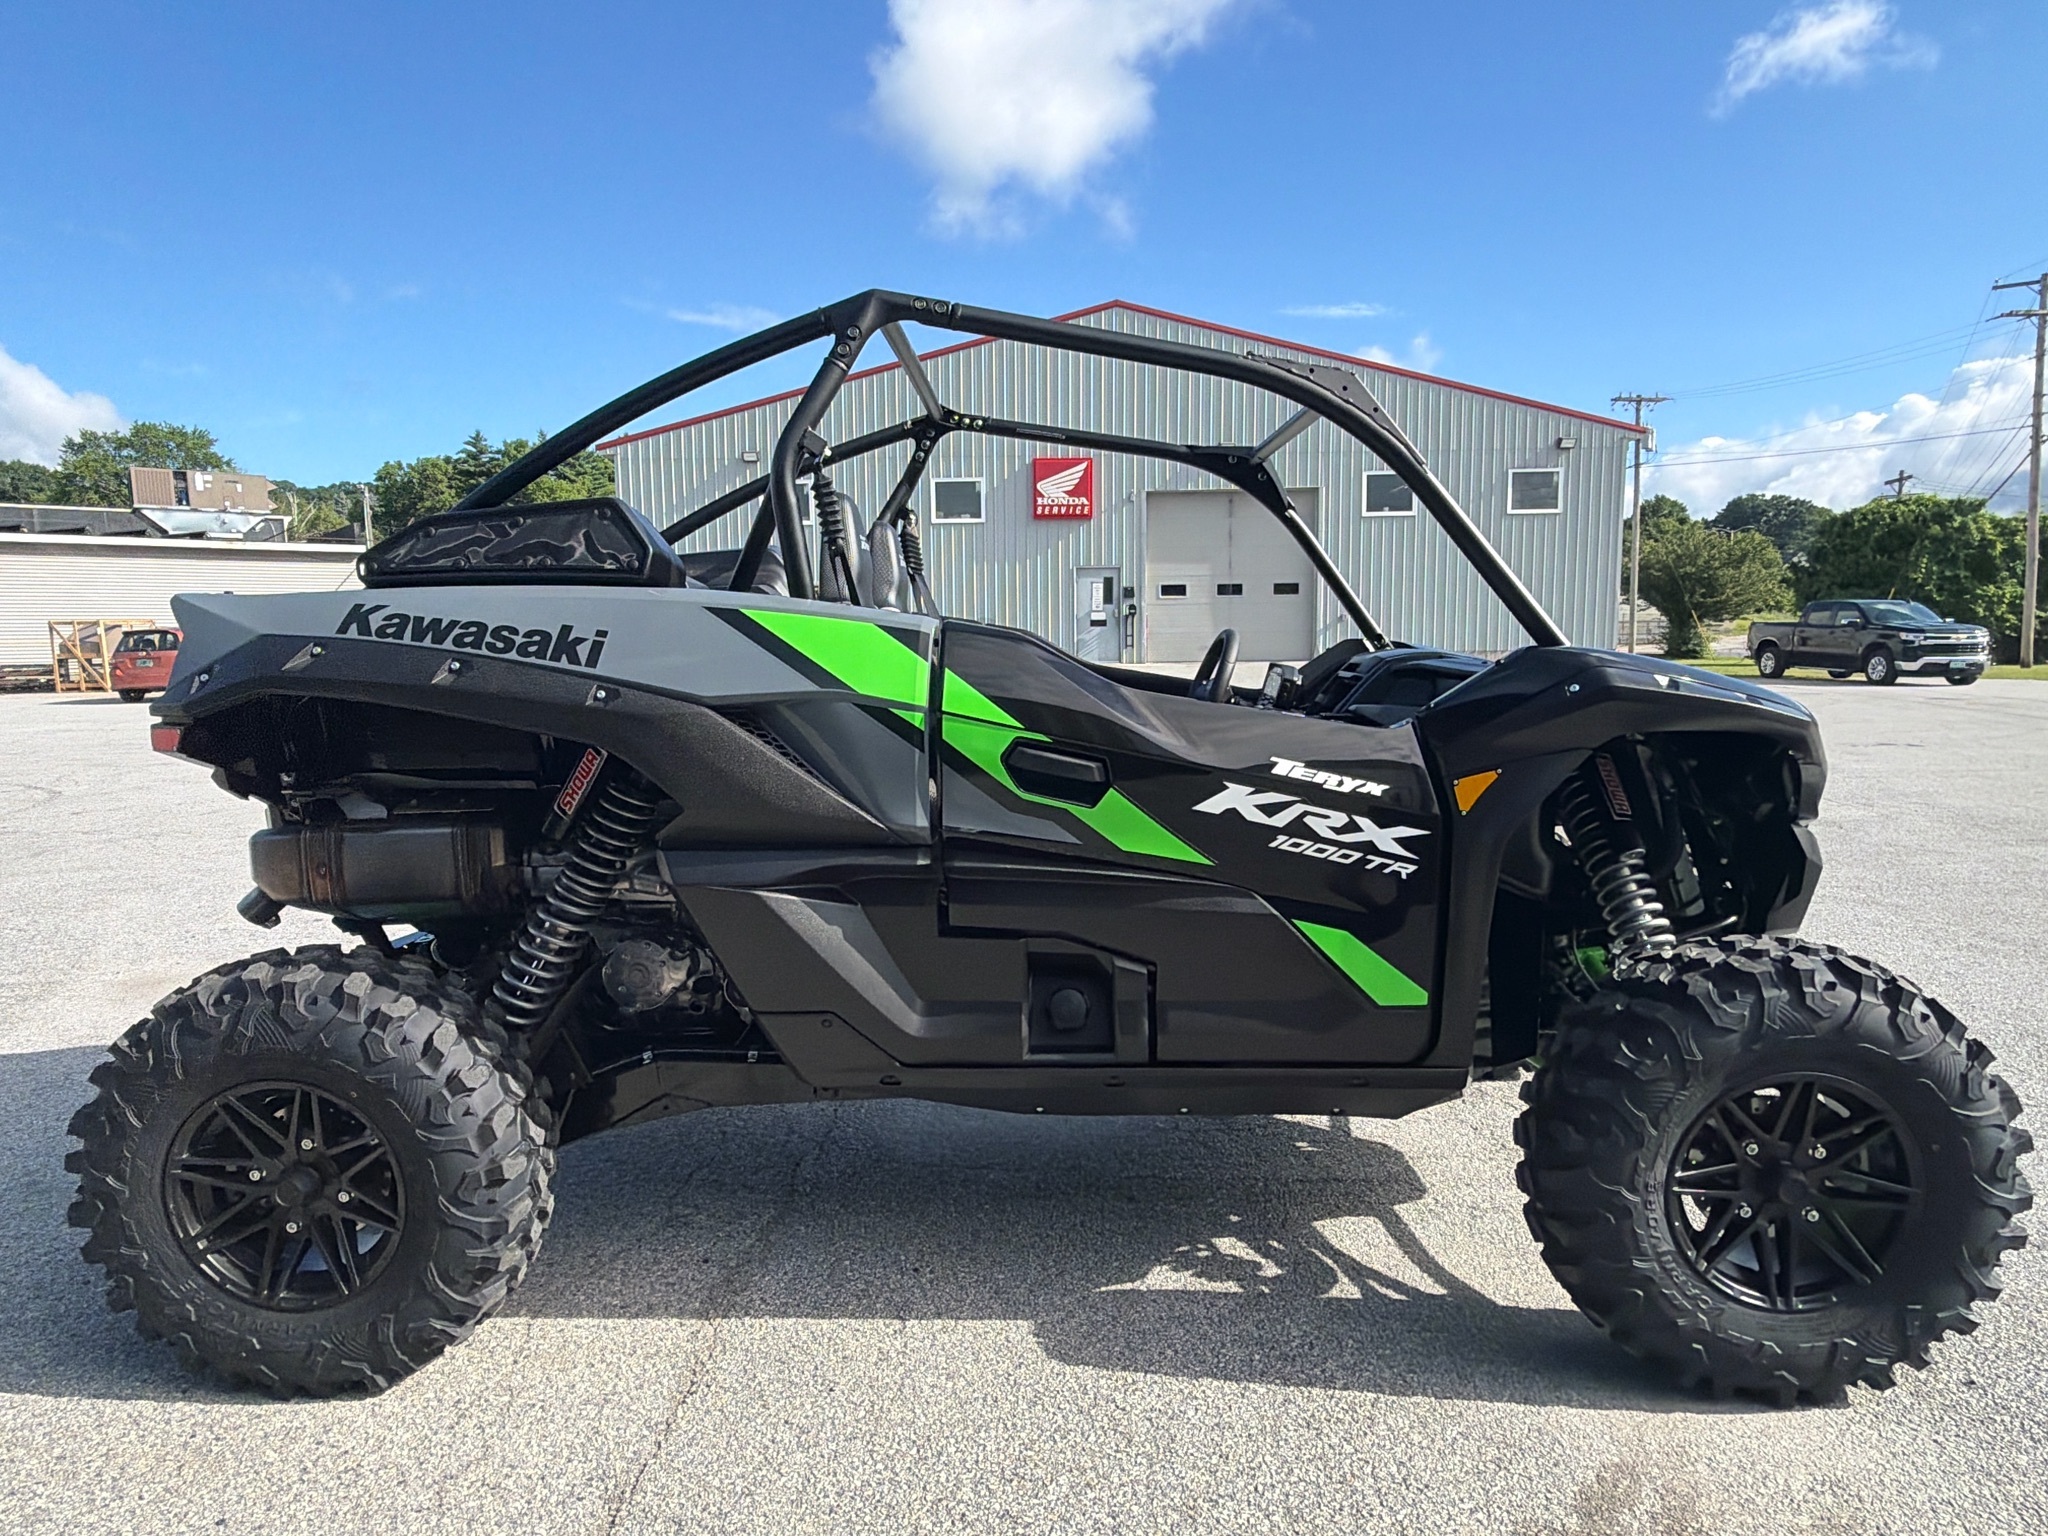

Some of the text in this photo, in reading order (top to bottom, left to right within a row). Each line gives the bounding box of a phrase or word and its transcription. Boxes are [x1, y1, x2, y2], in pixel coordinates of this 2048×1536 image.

[1036, 497, 1089, 505] HONDA
[1036, 506, 1089, 514] SERVICE
[335, 603, 609, 669] Kawasaki
[560, 748, 601, 815] SHOWA
[1270, 756, 1390, 796] TERYX
[1596, 758, 1632, 815] SHOWA
[1192, 780, 1432, 859] KRX
[1268, 835, 1419, 880] 1000 TR
